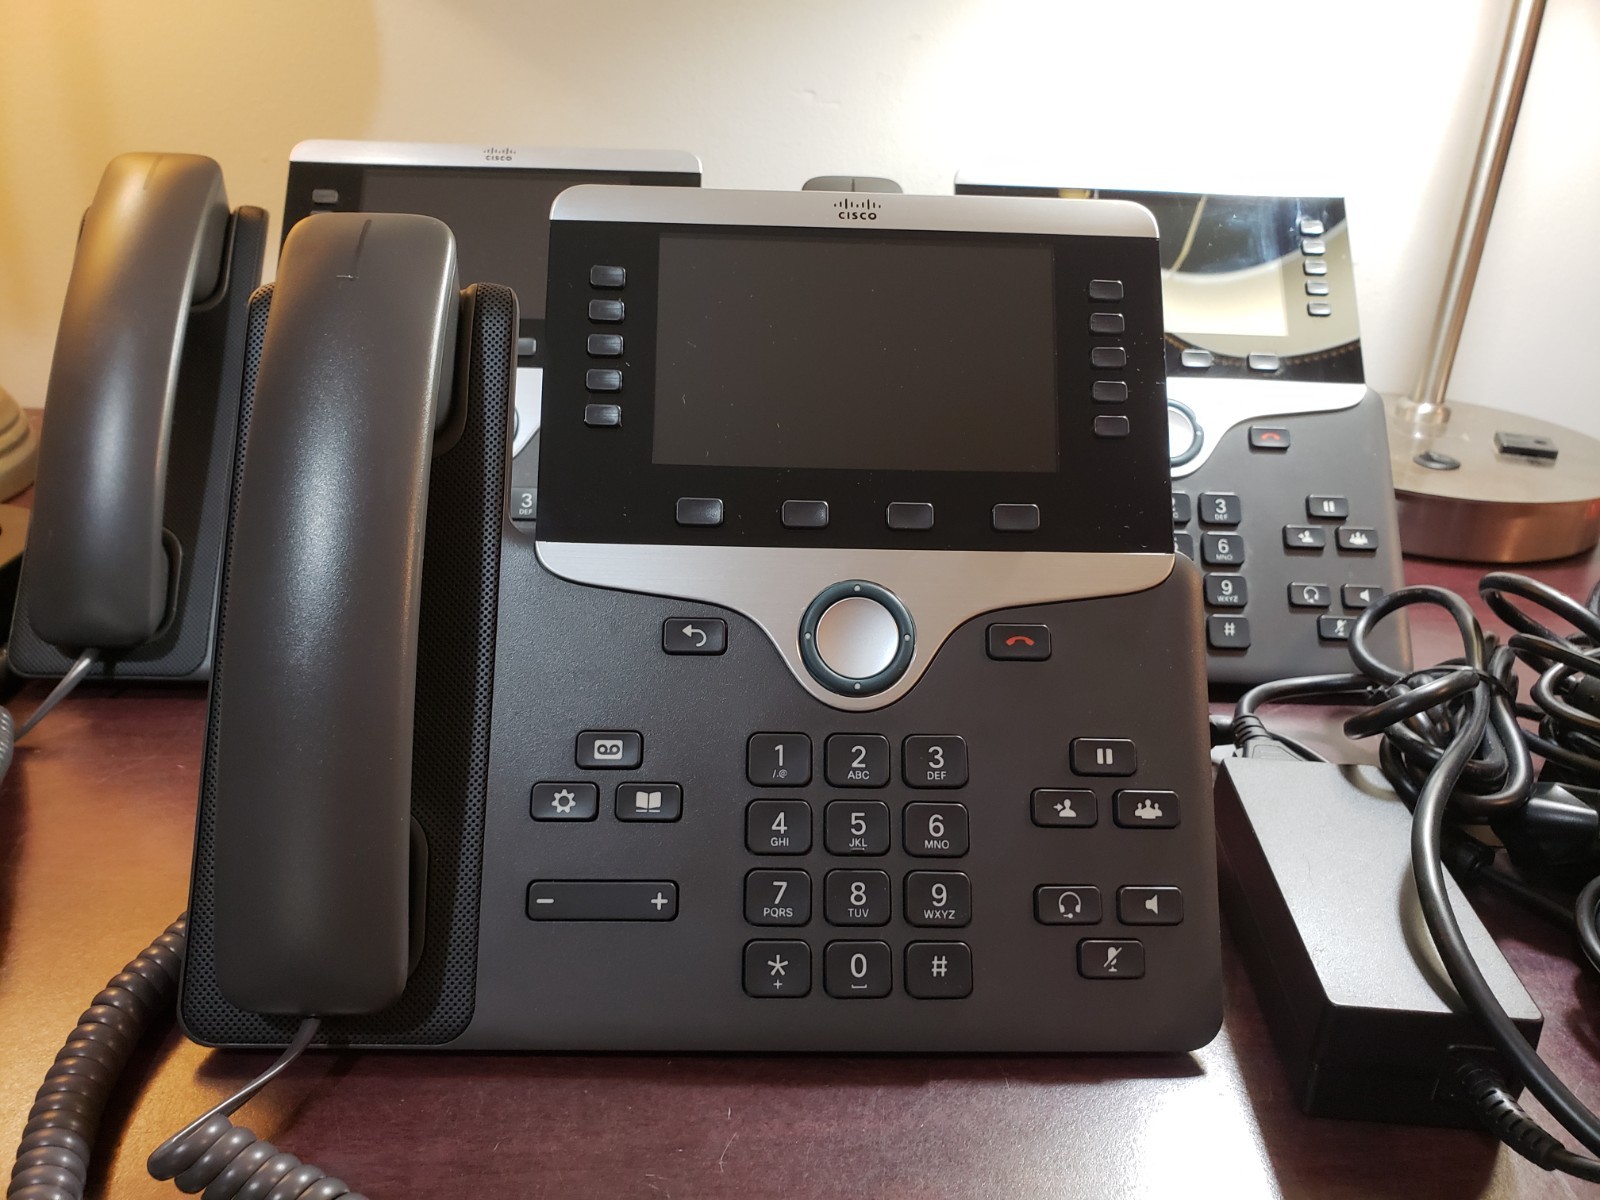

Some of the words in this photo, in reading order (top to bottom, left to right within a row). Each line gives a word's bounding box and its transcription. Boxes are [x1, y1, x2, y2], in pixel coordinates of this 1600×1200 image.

[838, 211, 877, 221] CISCO
[521, 492, 533, 508] 3
[1215, 498, 1227, 514] 3
[1214, 513, 1228, 521] DEF
[1217, 538, 1230, 554] 6
[1215, 553, 1233, 561] MNO
[1220, 579, 1233, 595] 9
[774, 744, 784, 767] 1
[851, 745, 866, 768] 2
[928, 746, 945, 769] 3
[847, 770, 870, 780] ABC
[927, 771, 947, 781] DEF
[771, 812, 788, 834] 4
[850, 812, 866, 835] 5
[928, 814, 945, 837] 6
[770, 837, 789, 847] GHI
[848, 837, 868, 848] JKL
[924, 839, 950, 849] MNO
[772, 881, 788, 904] 7
[850, 882, 867, 906] 8
[931, 883, 947, 907] 9
[763, 907, 793, 919] PQRS
[848, 908, 869, 918] TUV
[924, 909, 956, 920] WXYZ
[850, 953, 868, 978] 0
